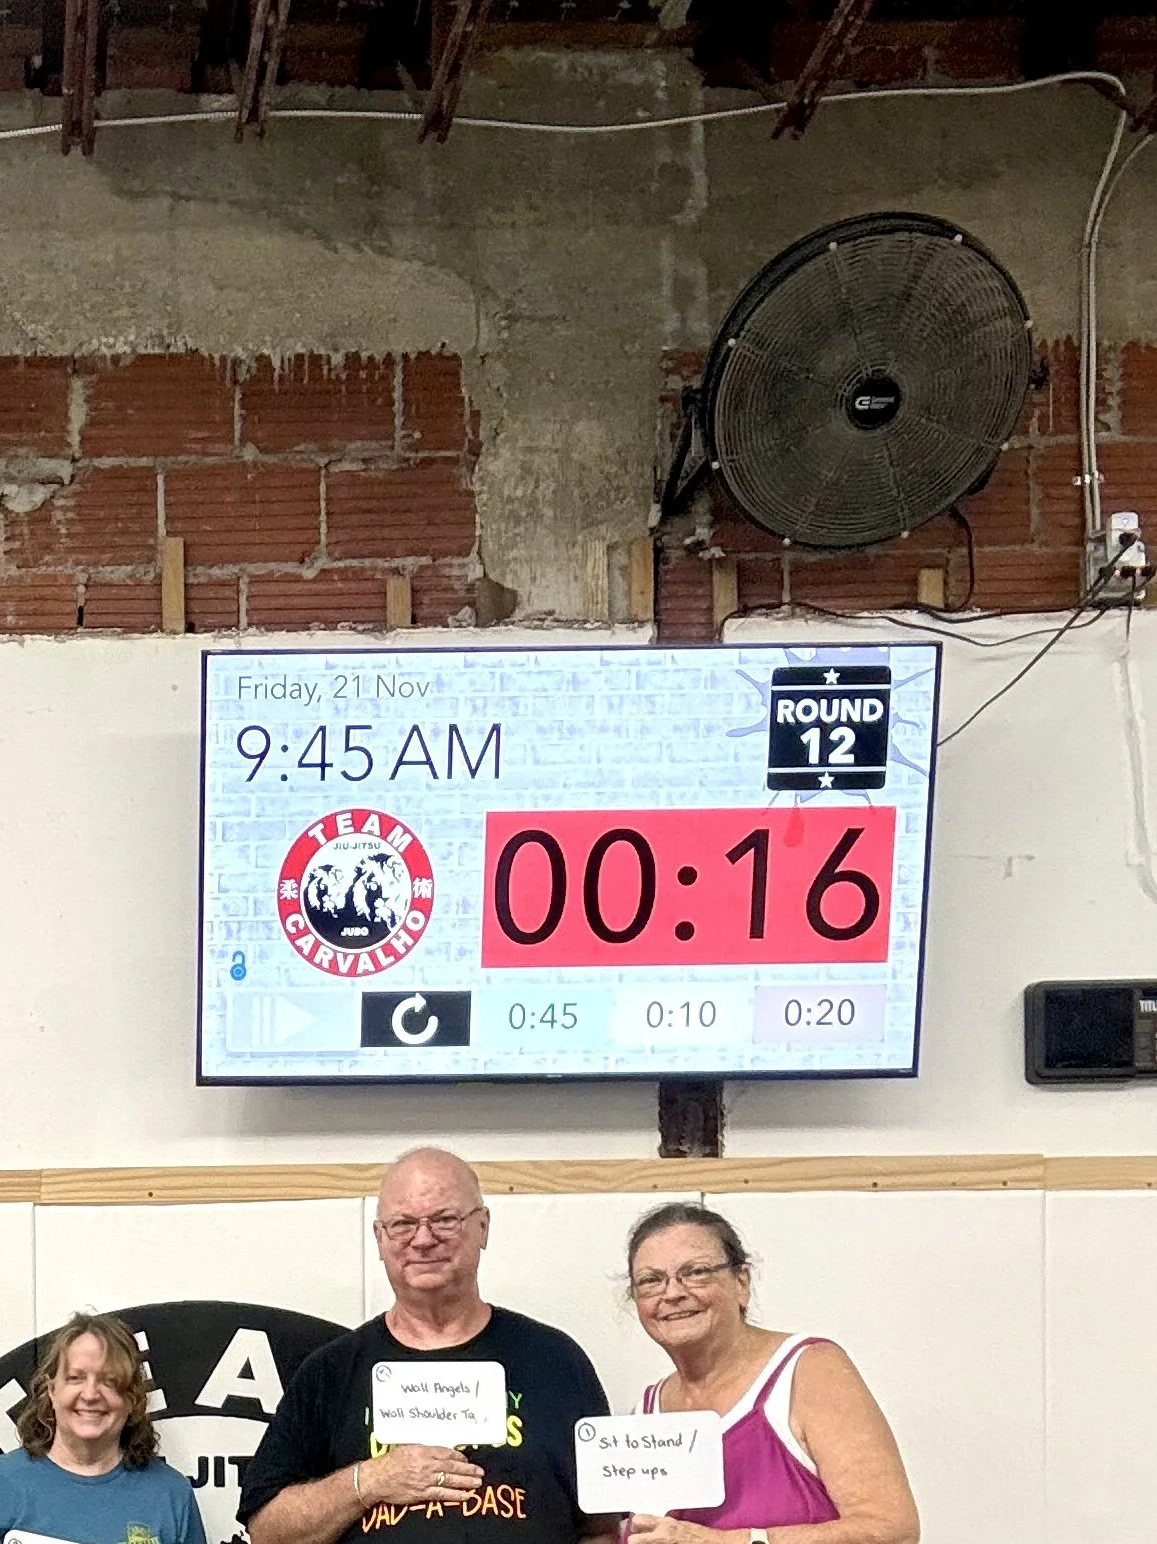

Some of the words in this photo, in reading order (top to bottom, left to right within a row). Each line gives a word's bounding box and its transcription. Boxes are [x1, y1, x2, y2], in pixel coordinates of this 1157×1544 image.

[238, 674, 322, 706] Friday,
[333, 674, 360, 698] 21
[376, 674, 430, 698] Nov
[777, 697, 884, 724] ROUND
[236, 725, 374, 782] 9:45
[389, 723, 502, 780] AM
[800, 726, 856, 765] 12
[307, 812, 413, 853] TEAM
[495, 828, 880, 945] 00:16
[285, 910, 426, 975] CARVALHO
[508, 1002, 578, 1030] 0:45
[646, 1000, 717, 1029] 0:10
[784, 998, 855, 1027] 0:20
[433, 1381, 471, 1398] Angels
[625, 1434, 639, 1449] to
[642, 1432, 683, 1450] Stand
[642, 1466, 668, 1480] ups
